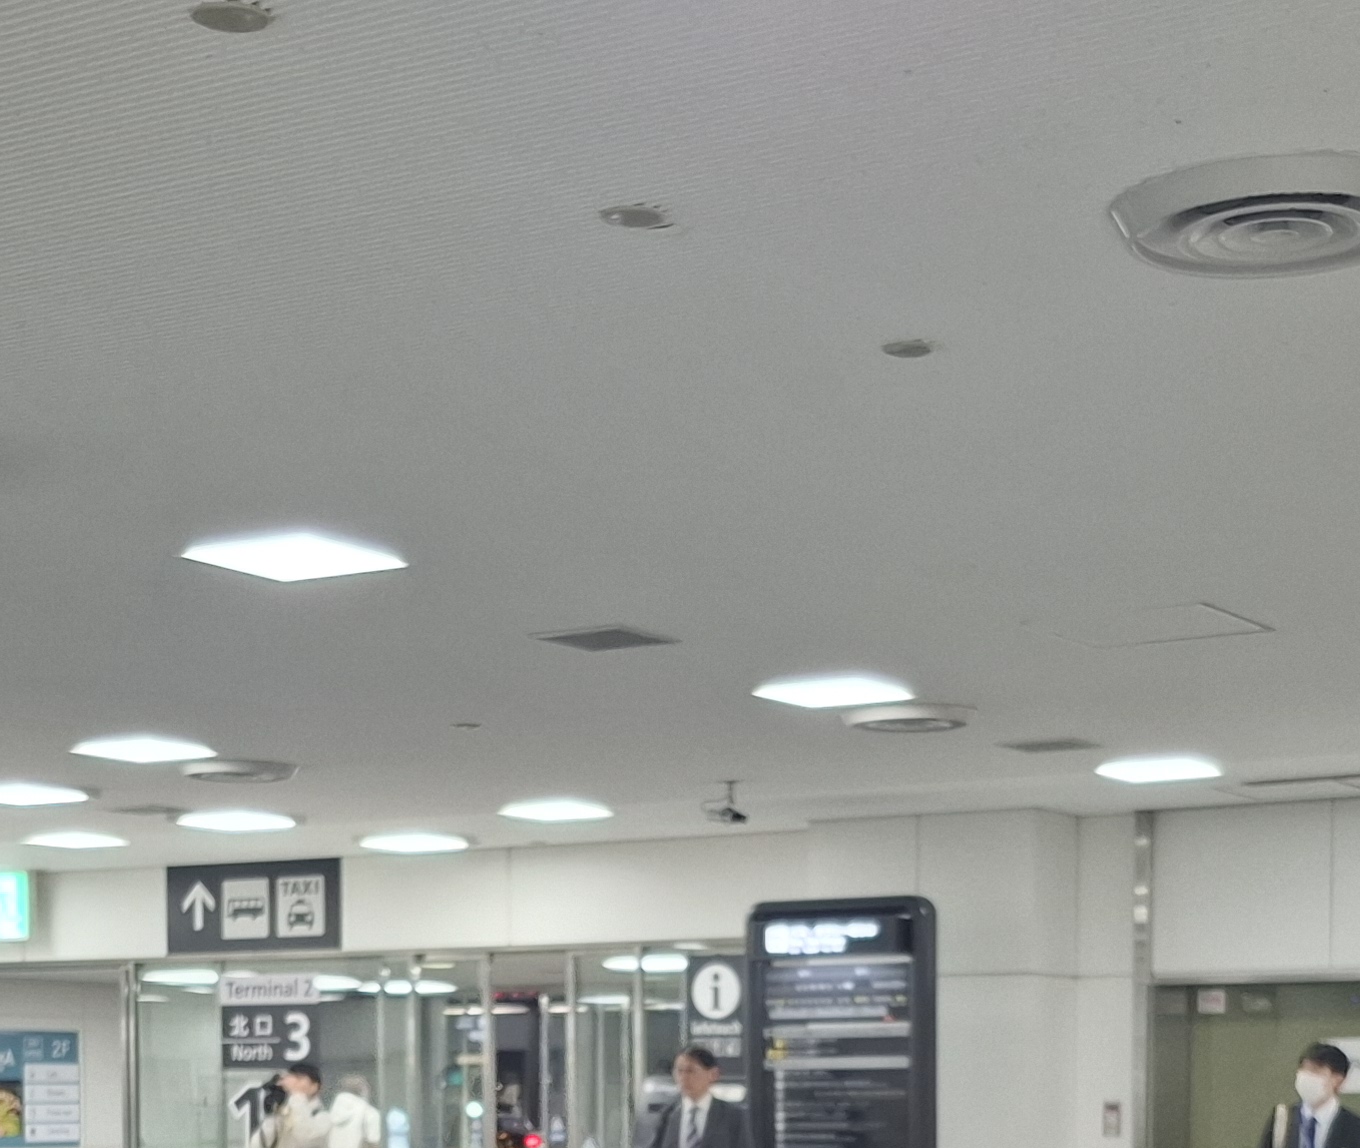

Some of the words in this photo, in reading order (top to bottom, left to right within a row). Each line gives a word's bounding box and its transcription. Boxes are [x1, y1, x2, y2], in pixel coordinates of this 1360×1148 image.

[280, 879, 320, 897] TAXI
[225, 978, 299, 1000] Terminal
[303, 978, 313, 998] 2
[229, 1013, 273, 1038] 北口
[283, 1010, 311, 1062] 3
[231, 1043, 274, 1062] North
